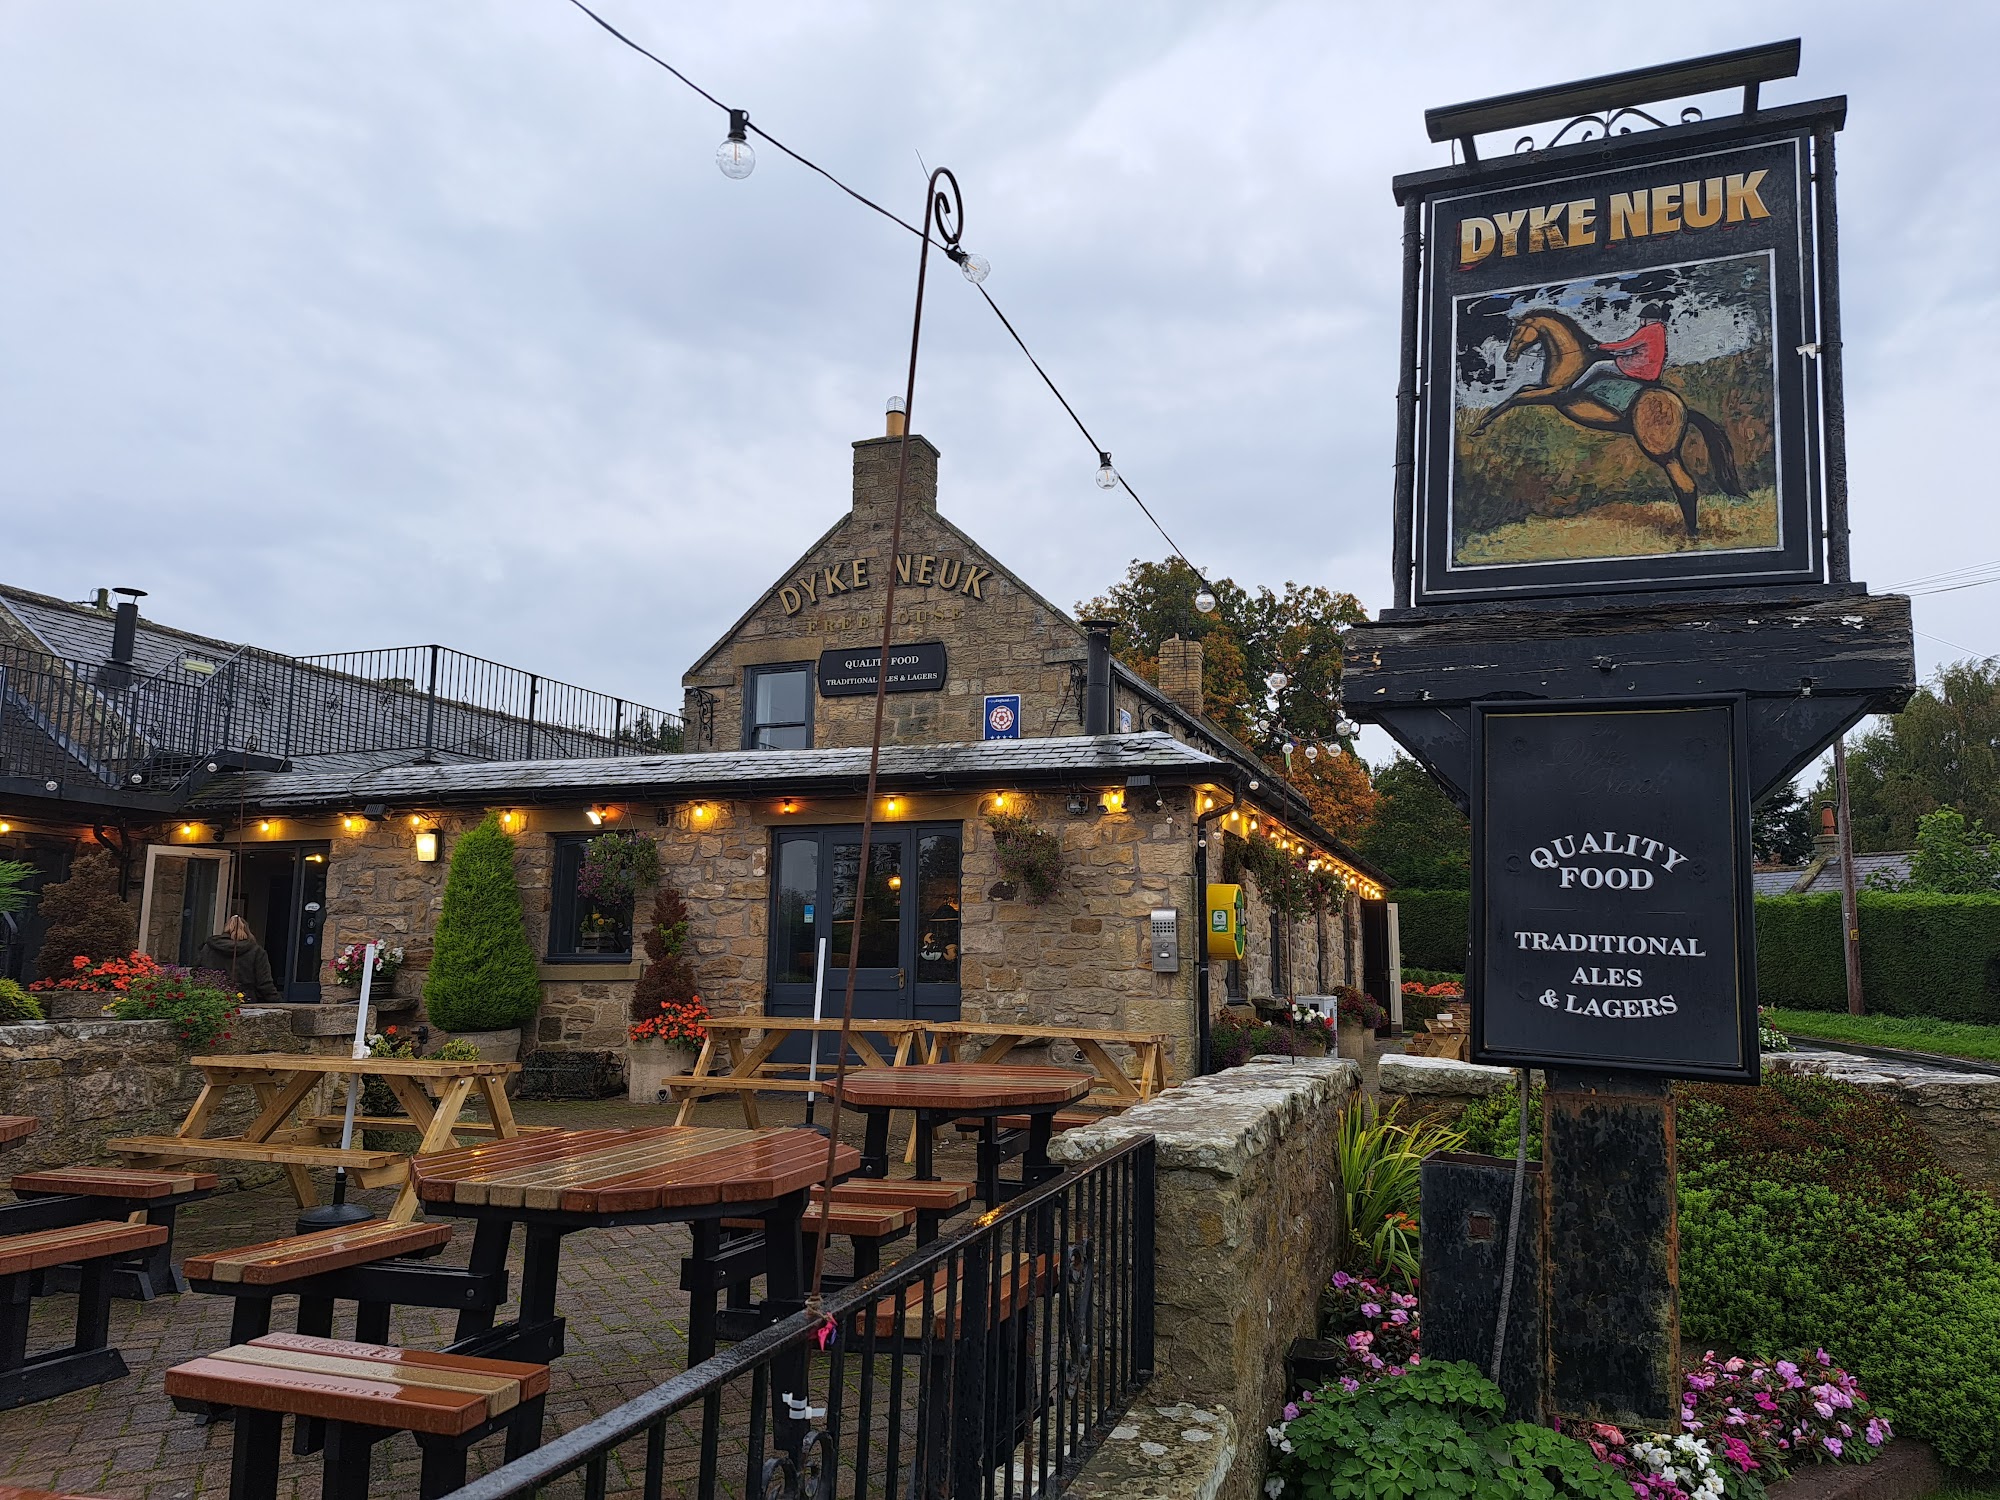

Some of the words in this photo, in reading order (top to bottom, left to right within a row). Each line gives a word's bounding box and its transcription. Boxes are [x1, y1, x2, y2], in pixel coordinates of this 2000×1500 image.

[1460, 198, 1596, 265] DYKE
[1609, 169, 1771, 241] NEUK
[779, 558, 869, 618] DYKE
[894, 554, 993, 601] NEUK
[845, 657, 889, 670] QUALIT
[891, 655, 919, 666] FOOD
[826, 677, 878, 687] TRADITIONAL
[883, 674, 899, 683] LES
[900, 674, 906, 682] &
[907, 672, 938, 681] LAGERS
[1529, 831, 1689, 873] QUALITY
[1559, 868, 1655, 890] FOOD
[1514, 931, 1707, 957] TRADITIONAL
[1570, 967, 1643, 988] ALES
[1539, 989, 1560, 1010] &
[1564, 994, 1679, 1019] LAGERS
